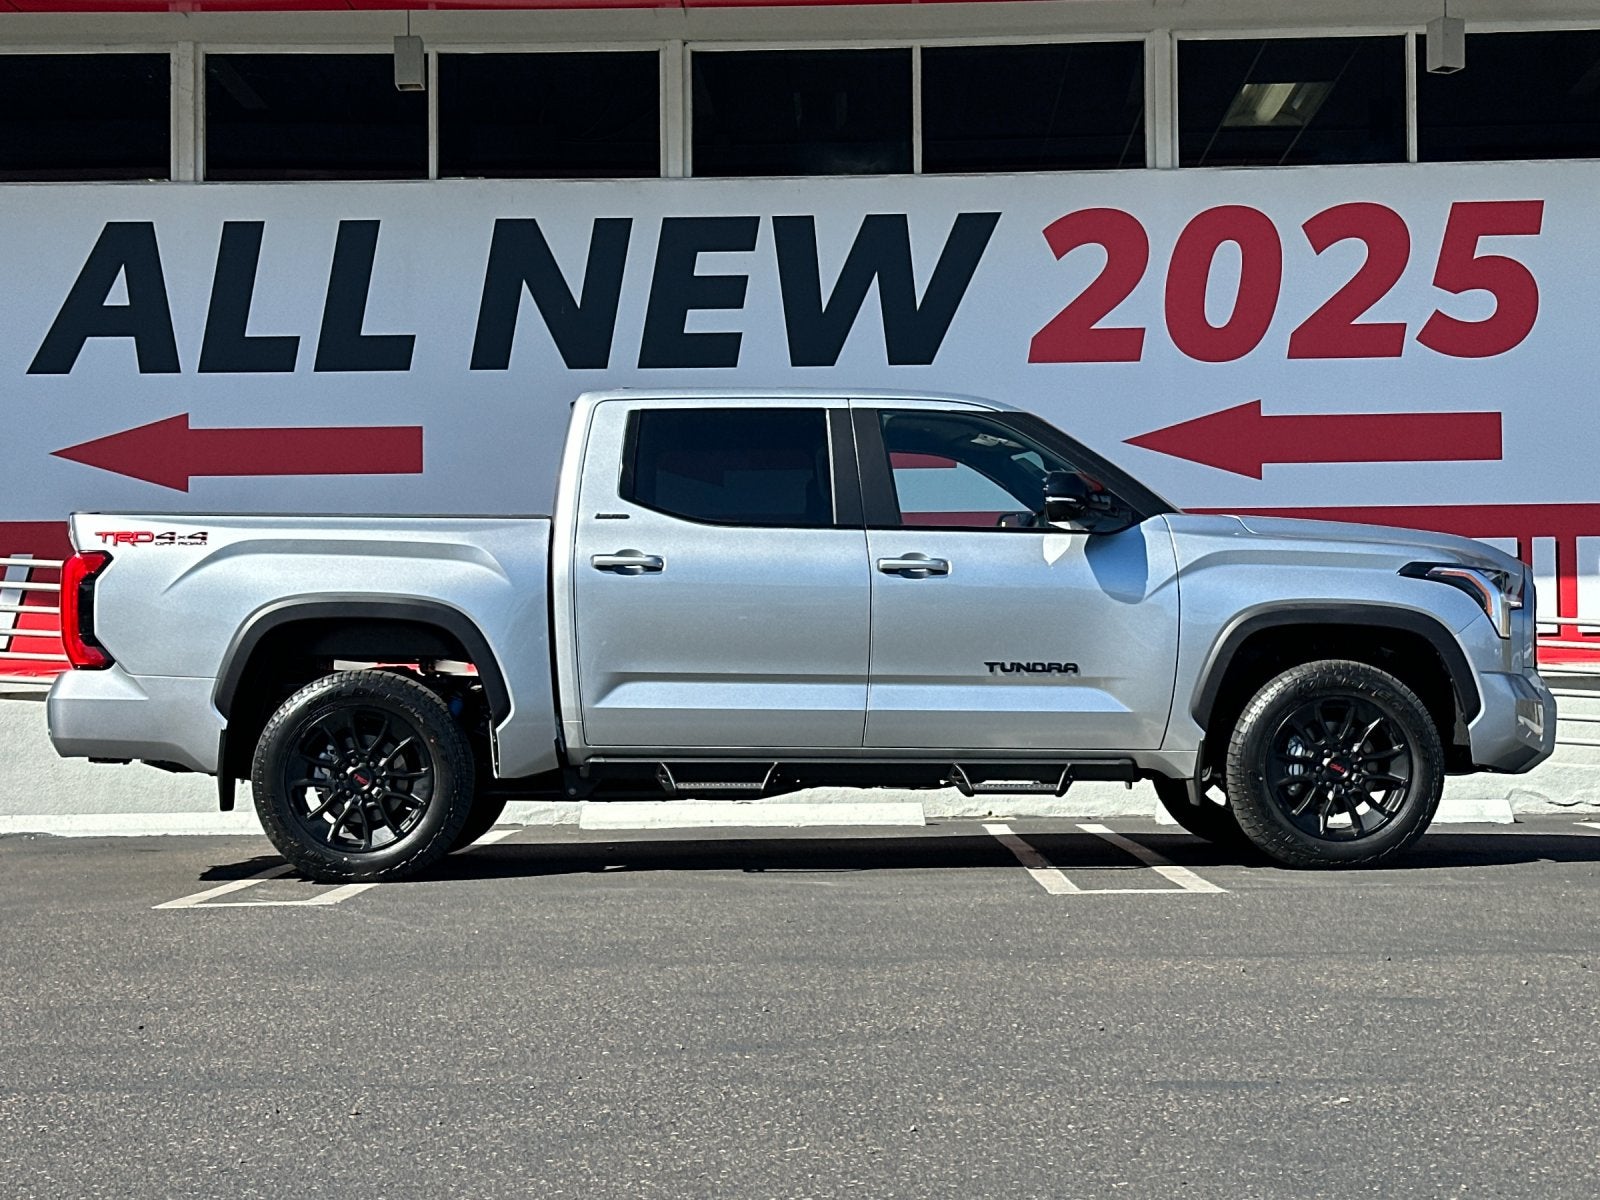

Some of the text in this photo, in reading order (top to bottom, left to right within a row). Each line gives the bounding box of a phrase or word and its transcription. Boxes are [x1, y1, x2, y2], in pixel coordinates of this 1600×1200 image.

[26, 199, 1545, 375] ALL NEW 2025
[94, 531, 155, 548] TRD
[983, 661, 1079, 674] TUNDRA
